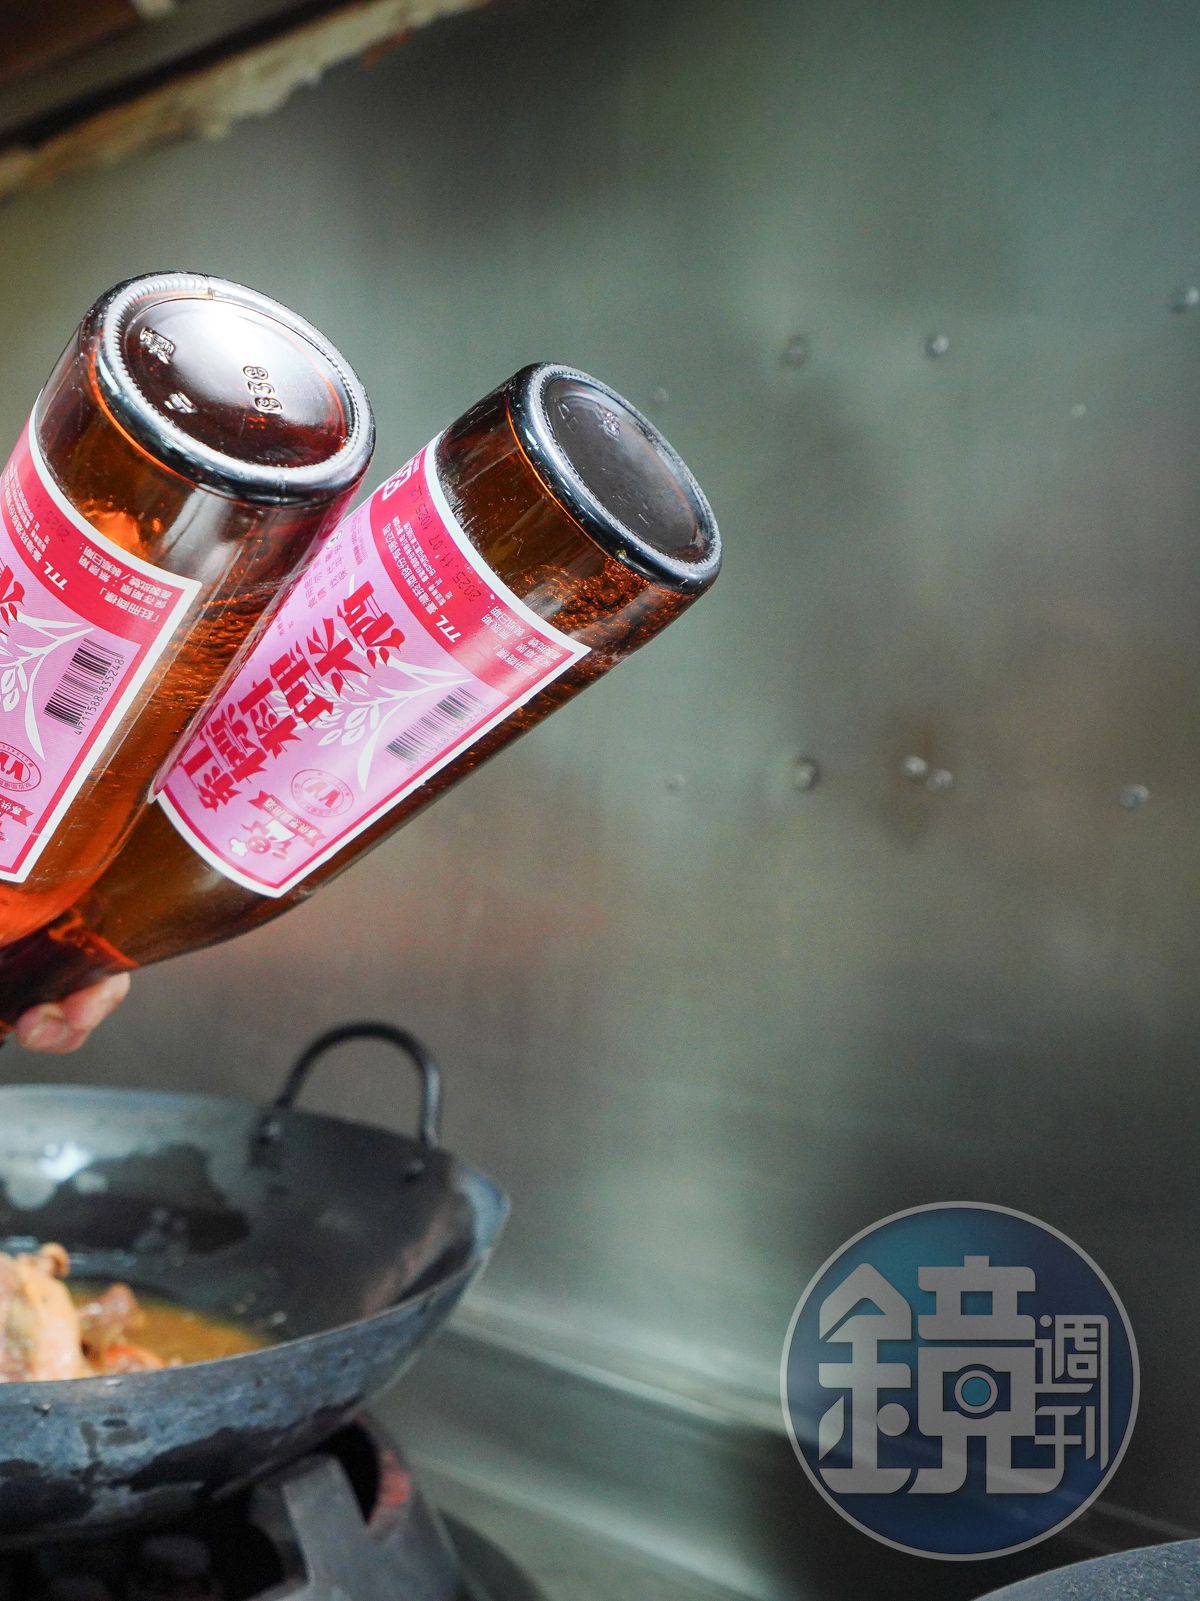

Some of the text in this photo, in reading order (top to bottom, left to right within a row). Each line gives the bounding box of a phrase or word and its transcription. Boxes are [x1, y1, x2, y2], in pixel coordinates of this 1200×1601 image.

[44, 561, 67, 590] TTL
[435, 614, 461, 642] TTL
[178, 580, 405, 812] 紅標料理米酒
